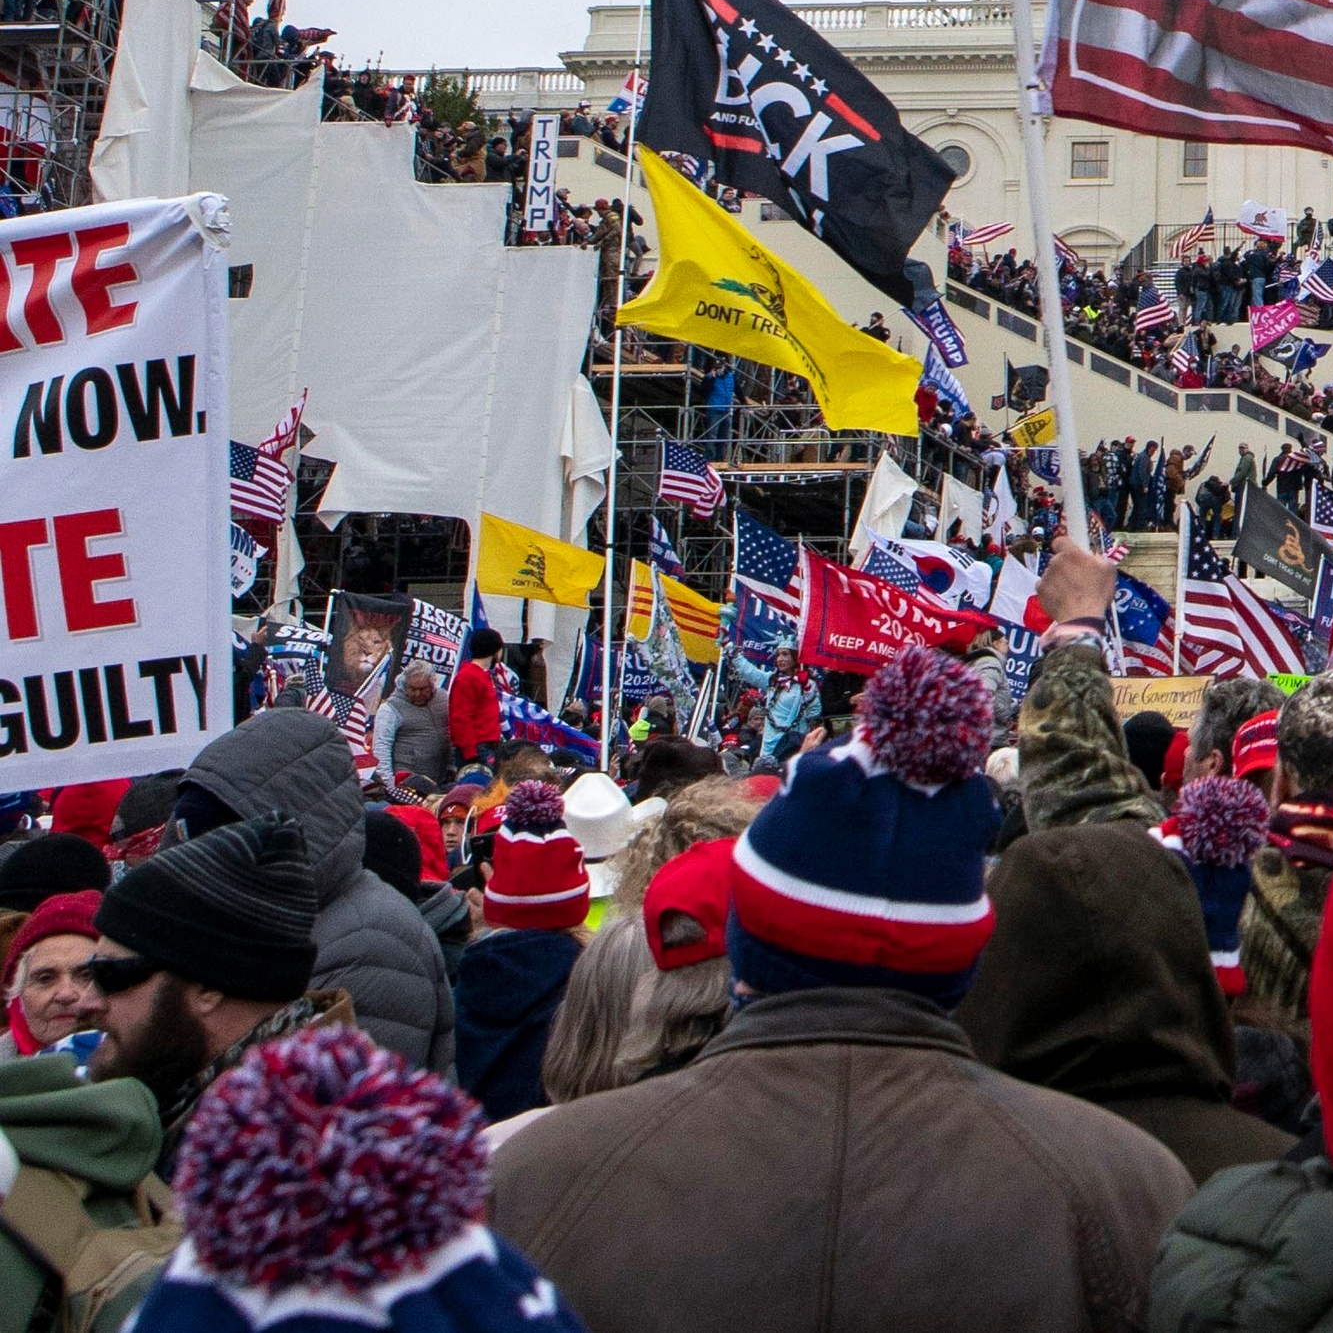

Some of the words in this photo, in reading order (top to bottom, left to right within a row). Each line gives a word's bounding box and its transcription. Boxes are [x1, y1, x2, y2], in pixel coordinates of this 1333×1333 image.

[711, 112, 737, 124] AND
[529, 119, 553, 229] TRUMP
[0, 222, 140, 355] TE
[927, 301, 963, 364] TRUMP
[13, 354, 207, 459] NOW.
[421, 622, 439, 635] MY
[828, 633, 864, 650] KEEP
[624, 673, 658, 686] 2020
[1114, 684, 1138, 706] The
